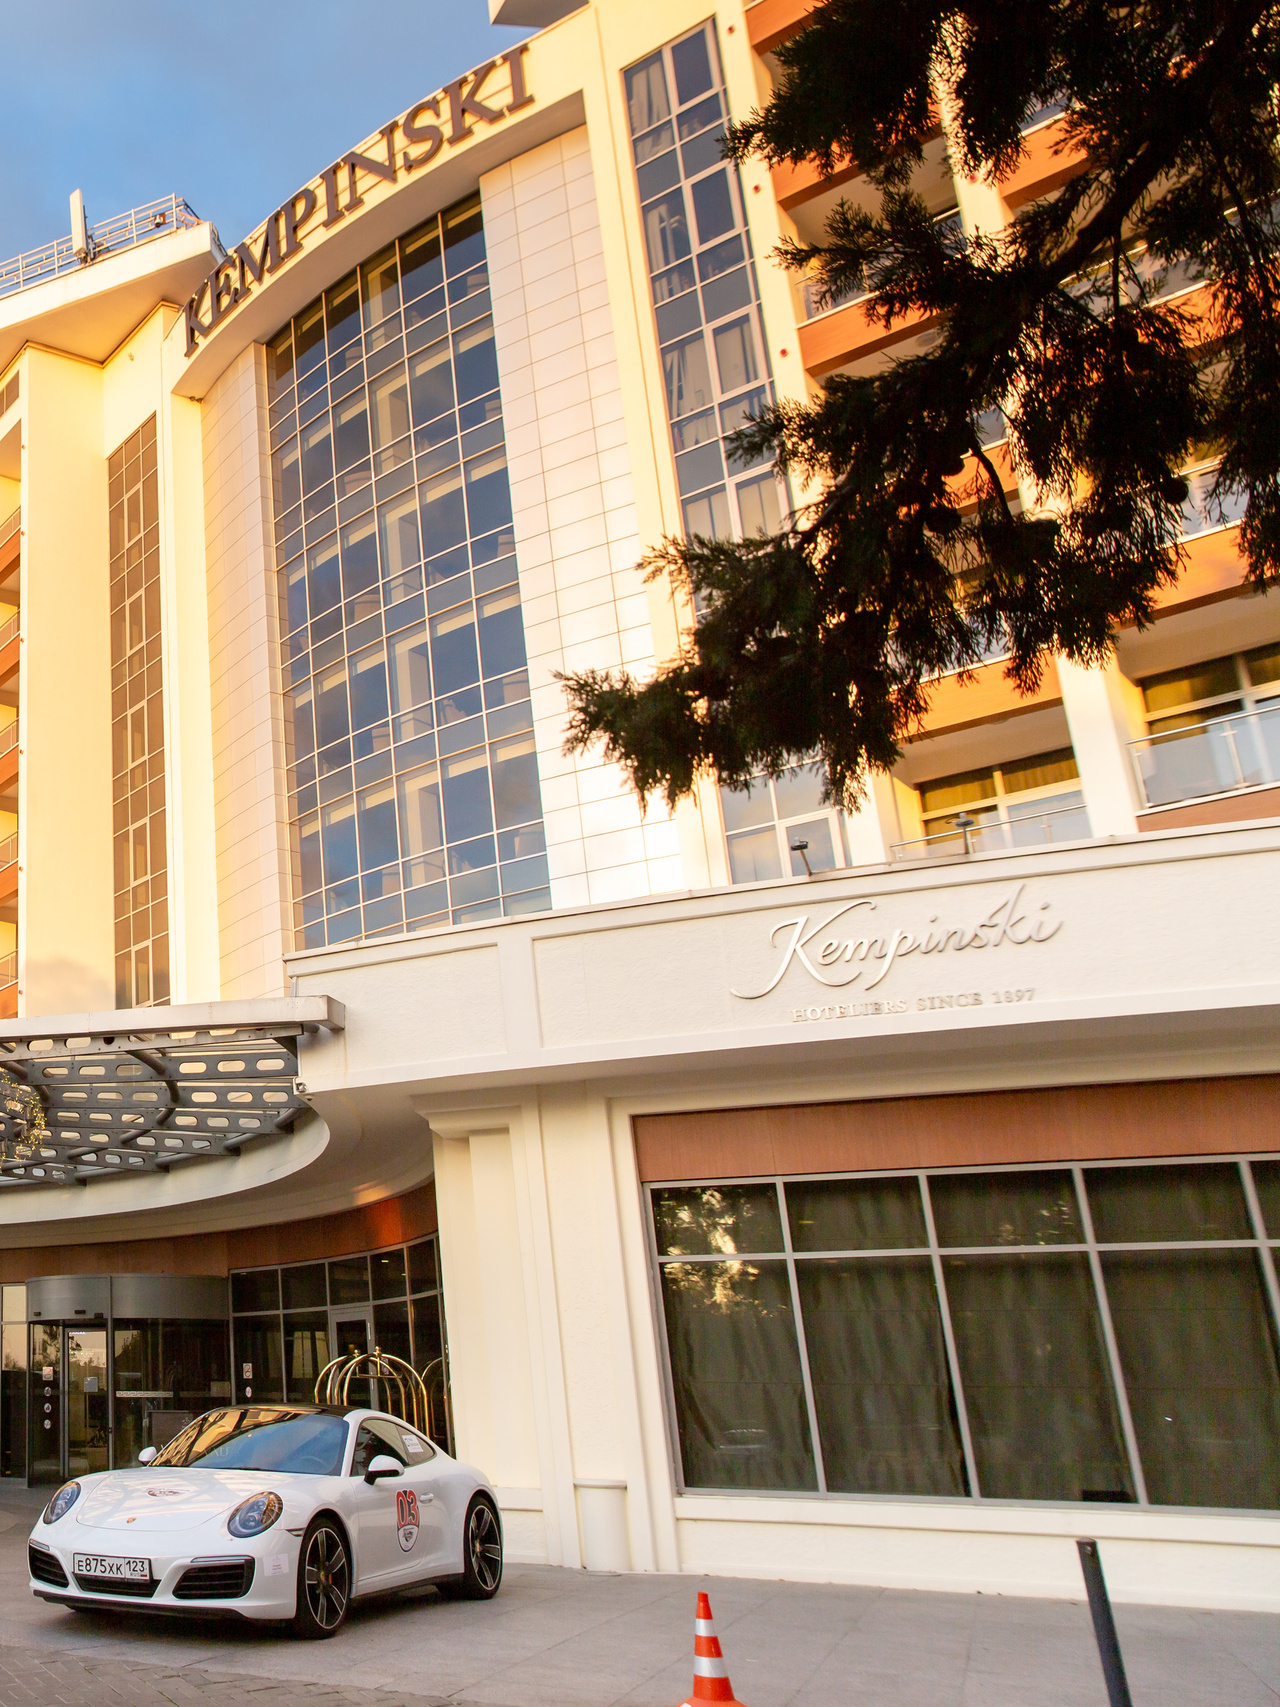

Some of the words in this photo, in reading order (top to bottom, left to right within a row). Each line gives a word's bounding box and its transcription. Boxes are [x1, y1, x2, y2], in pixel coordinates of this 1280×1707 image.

[184, 43, 535, 357] KEMPINSKI
[731, 884, 1063, 999] Kempinski
[791, 999, 908, 1023] HOTELIERS
[916, 992, 983, 1012] SINCE
[992, 987, 1036, 1005] 1897
[396, 1490, 419, 1528] 03
[125, 1560, 145, 1572] 123
